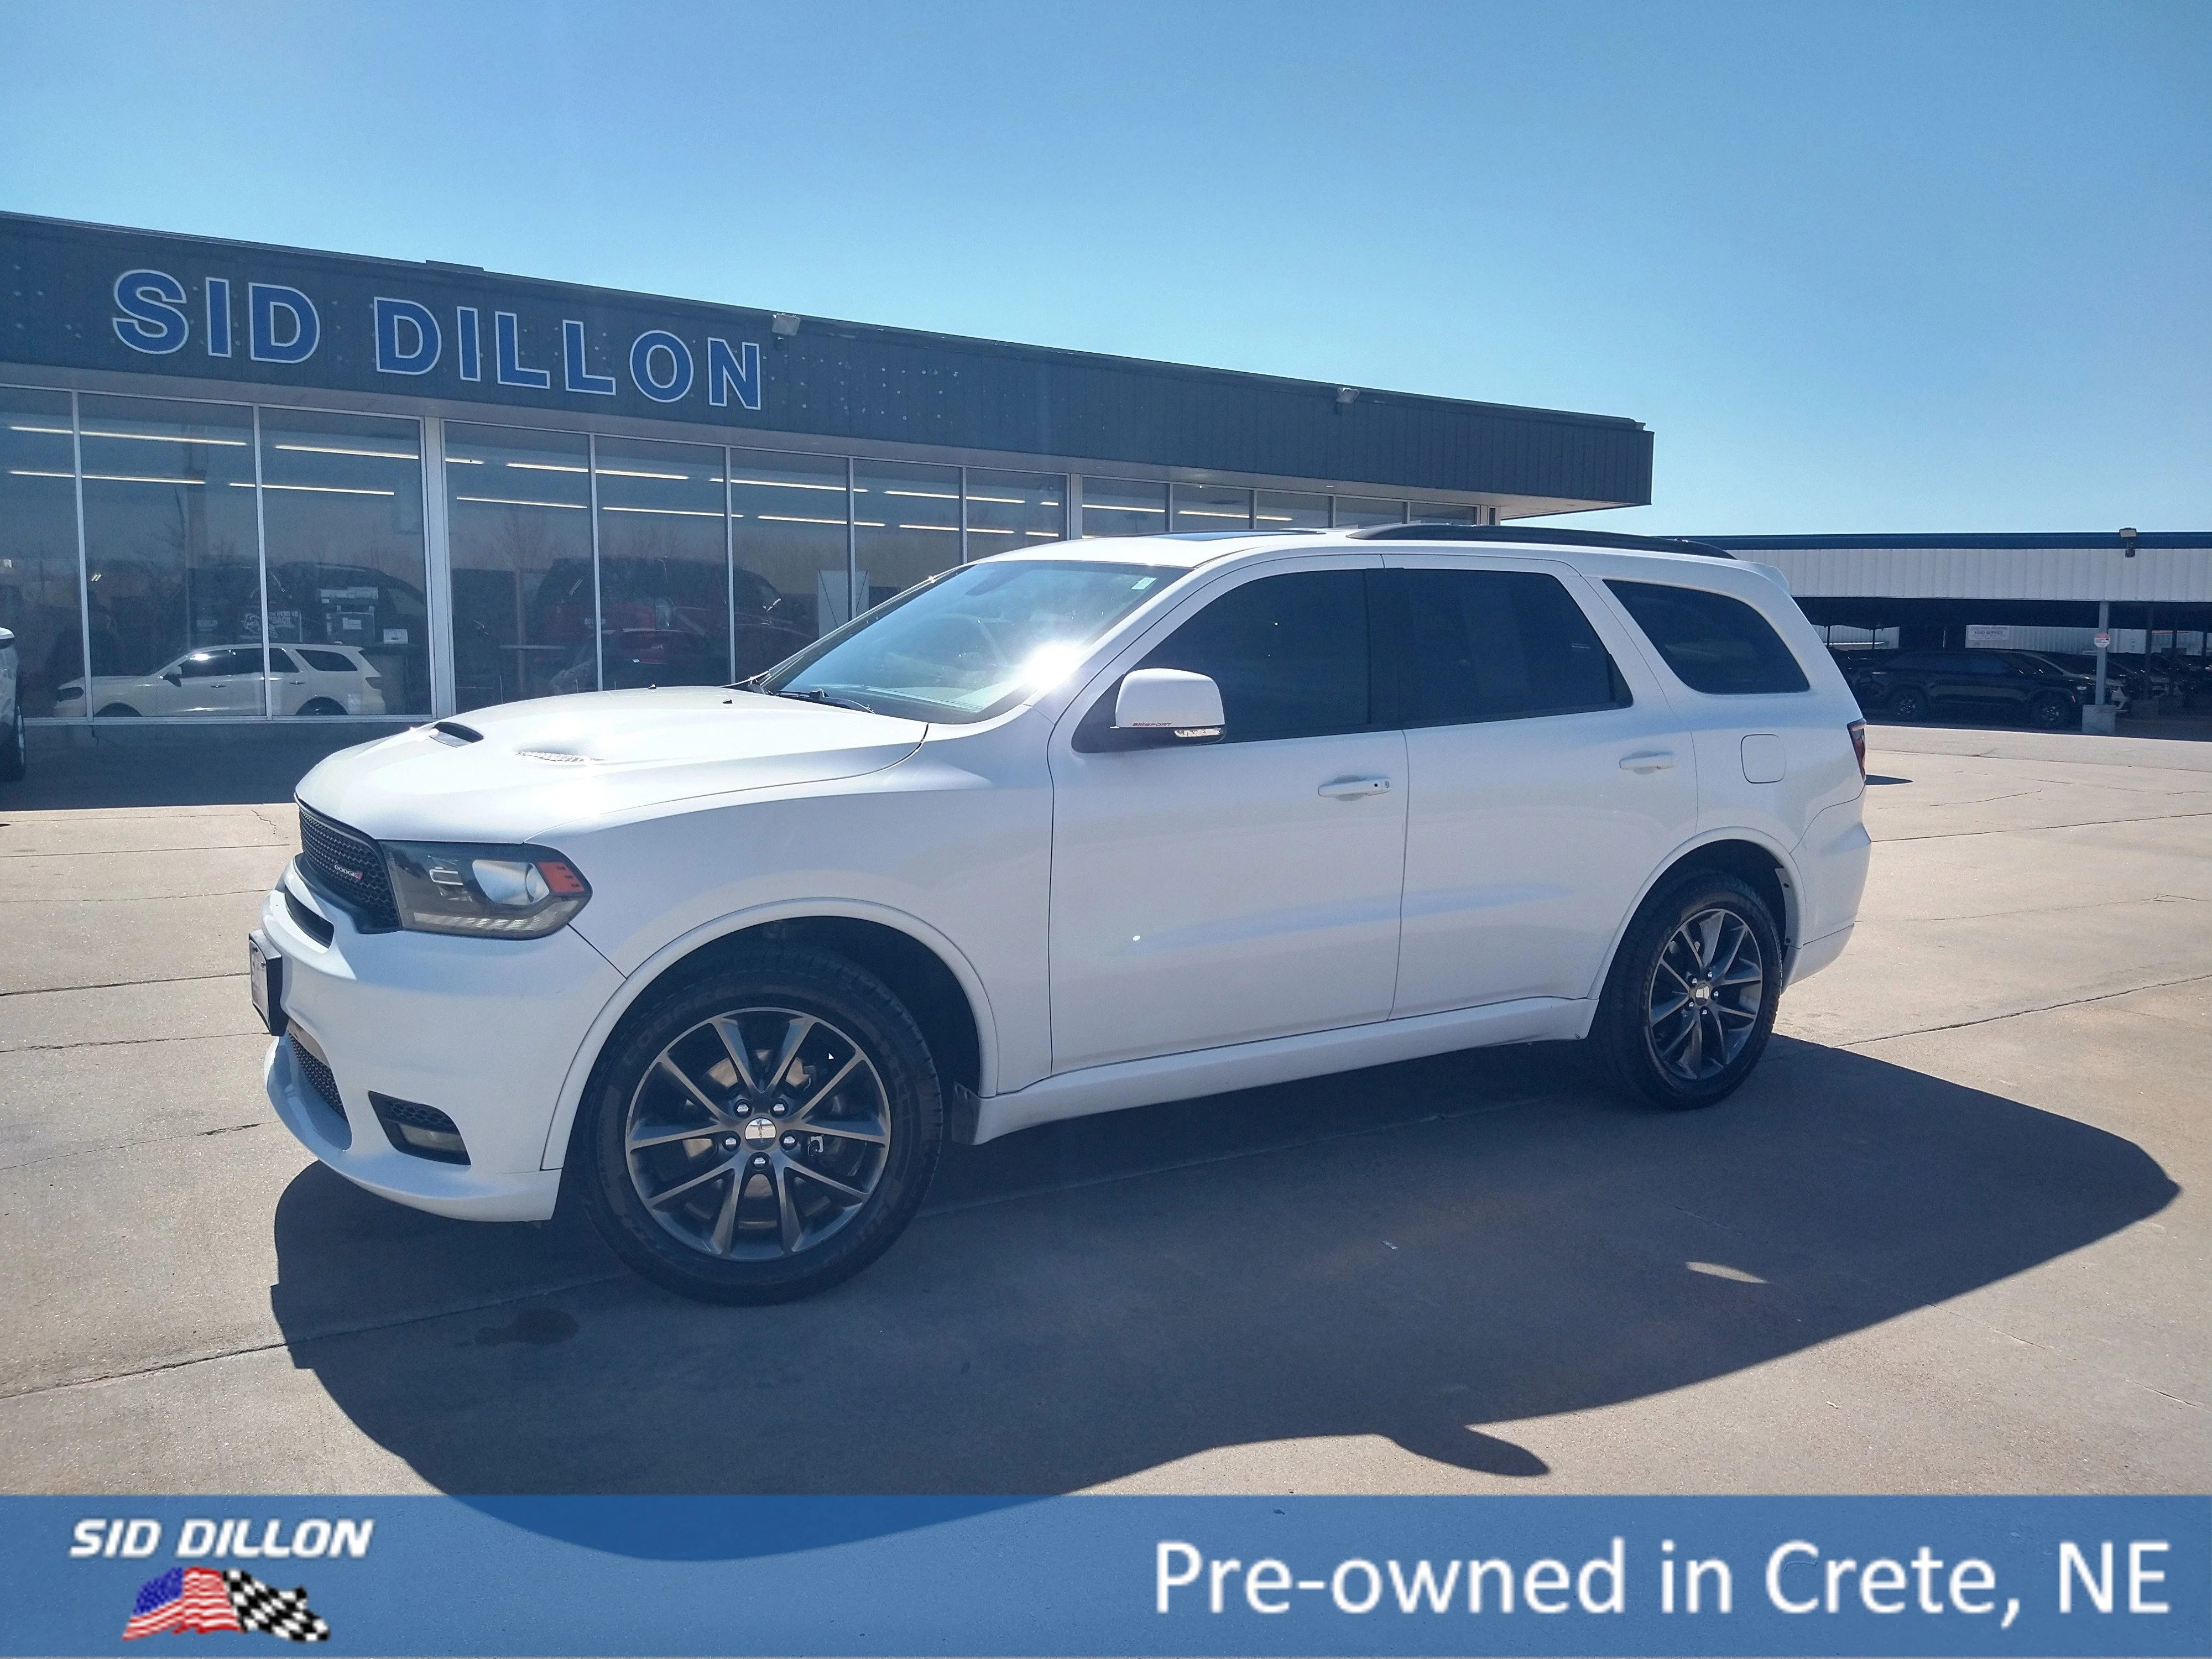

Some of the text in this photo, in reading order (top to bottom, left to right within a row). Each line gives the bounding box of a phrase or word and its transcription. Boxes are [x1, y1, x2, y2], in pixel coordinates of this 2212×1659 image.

[112, 269, 761, 410] SID DILLON
[335, 865, 358, 878] DODGE
